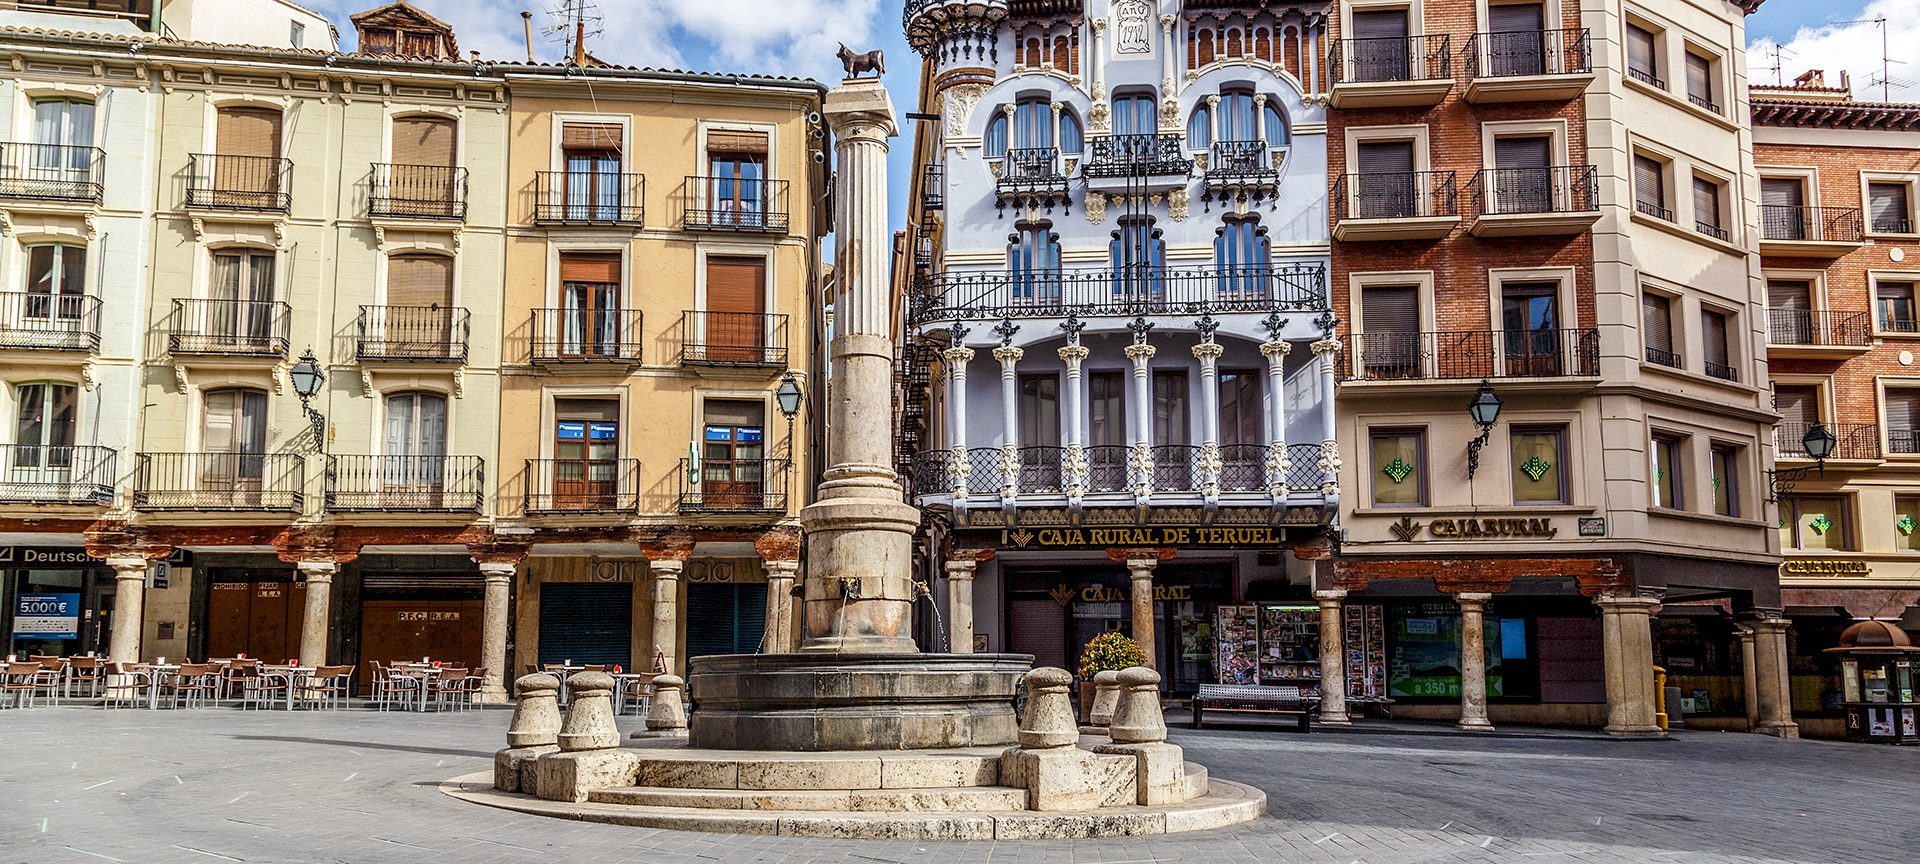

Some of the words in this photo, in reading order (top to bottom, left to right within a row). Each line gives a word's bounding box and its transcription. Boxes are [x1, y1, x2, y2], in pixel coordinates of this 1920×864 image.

[1122, 25, 1146, 44] 1912
[1038, 529, 1086, 546] CAJA
[1090, 529, 1159, 544] RURAL
[1163, 528, 1190, 544] DE
[1196, 528, 1280, 544] TERUEL
[587, 554, 734, 583] farmcia
[1081, 587, 1125, 602] CAJA
[1128, 586, 1190, 601] RAL
[399, 612, 427, 620] P.F.C.
[1414, 684, 1422, 694] a
[1425, 683, 1446, 694] 350
